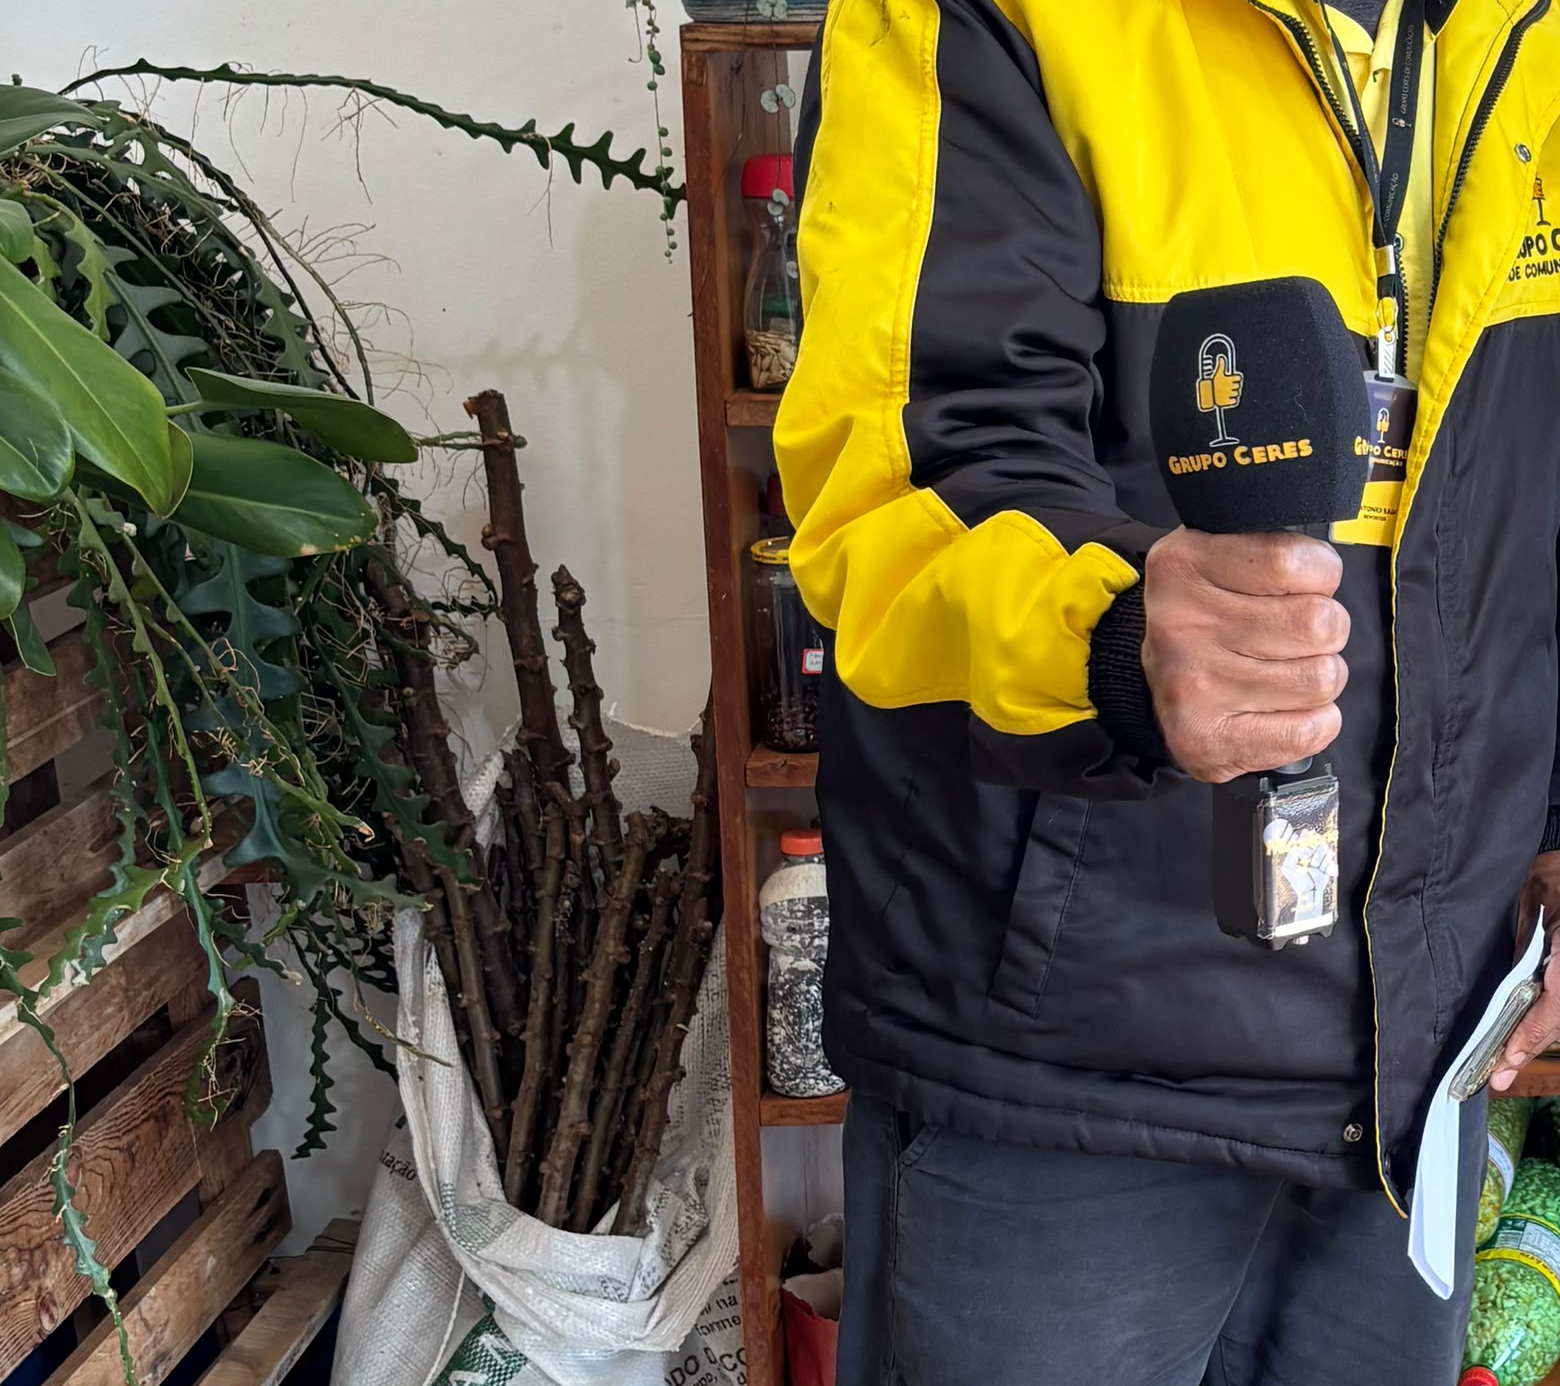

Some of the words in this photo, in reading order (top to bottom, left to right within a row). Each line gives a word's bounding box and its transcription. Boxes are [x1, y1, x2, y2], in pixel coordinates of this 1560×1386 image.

[1517, 233, 1548, 259] UPO
[1168, 451, 1227, 475] GRUPO
[1233, 438, 1313, 466] CERES
